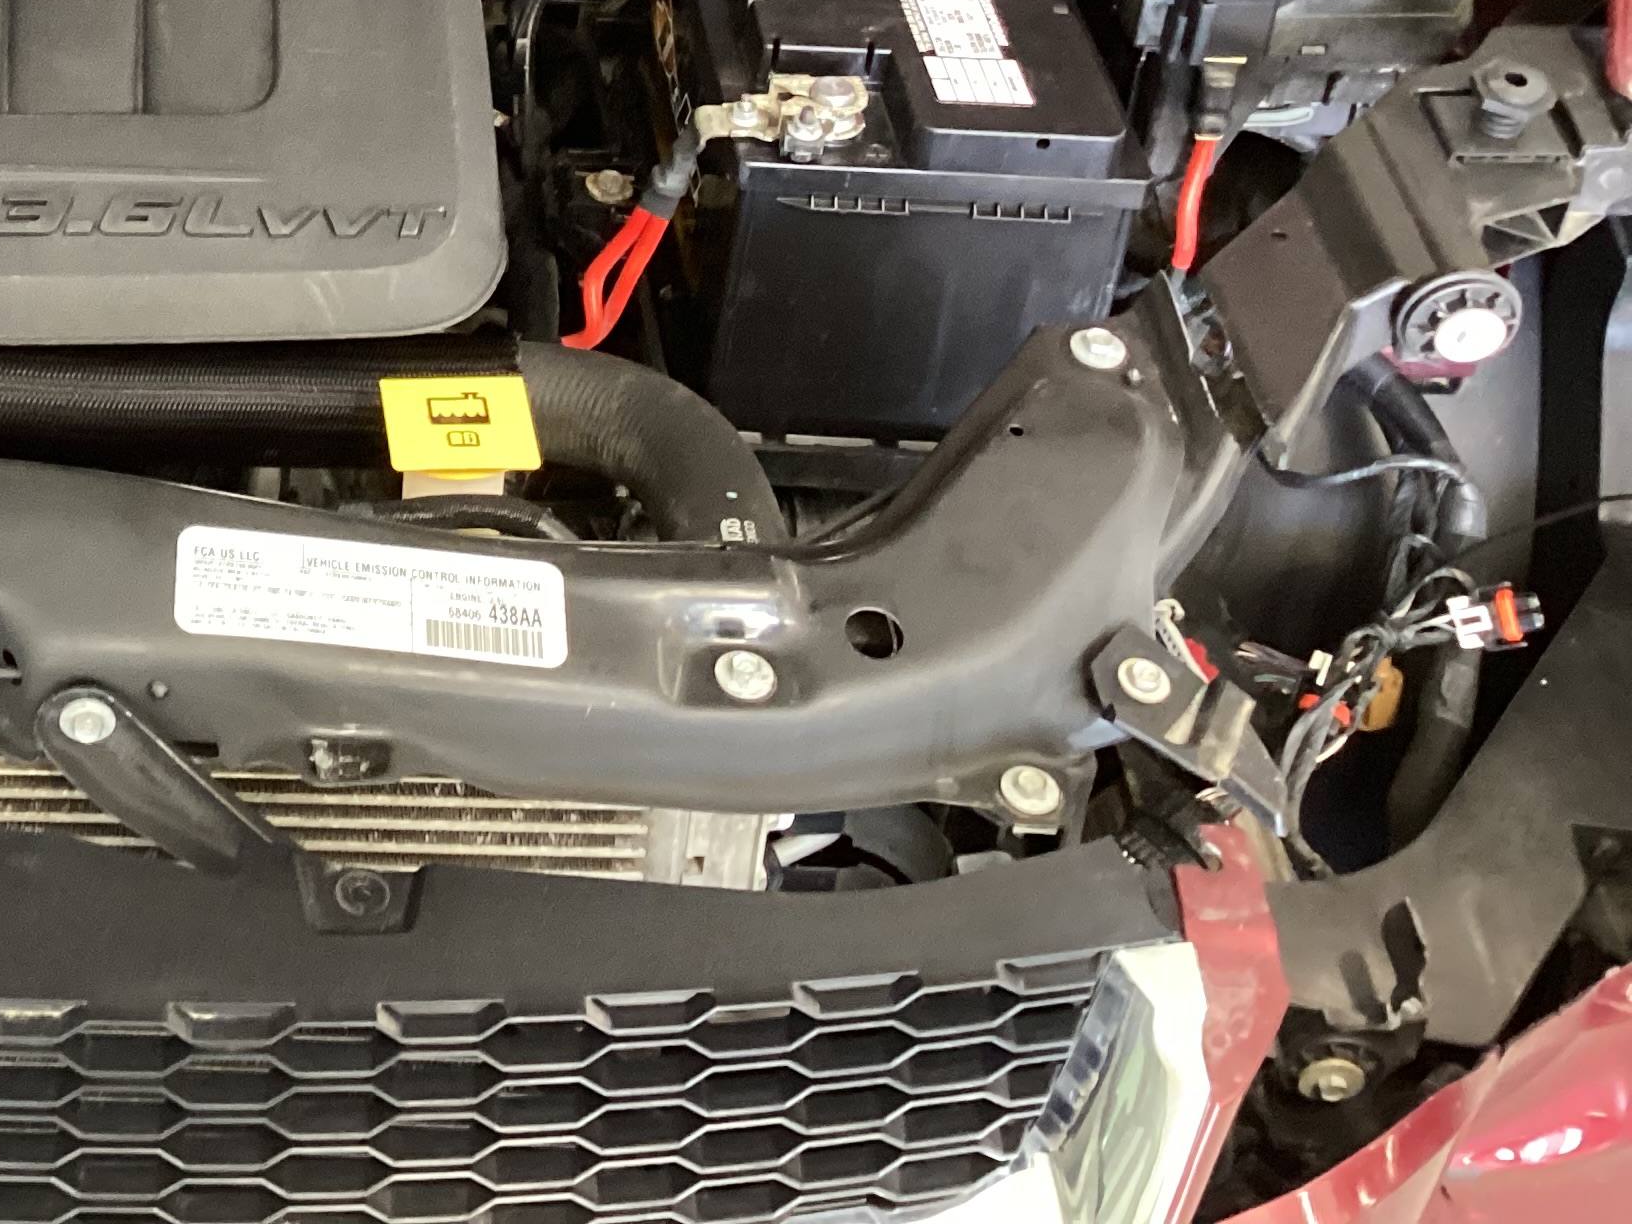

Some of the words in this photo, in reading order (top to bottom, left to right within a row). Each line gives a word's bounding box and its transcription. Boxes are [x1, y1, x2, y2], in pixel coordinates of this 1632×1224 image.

[193, 545, 216, 558] FCA
[220, 547, 236, 561] US
[239, 550, 261, 563] LLC
[306, 556, 350, 573] VEHICLE
[355, 561, 407, 579] EMISSION
[411, 567, 461, 585] CONTROL
[465, 574, 542, 593] INFORMATION
[488, 604, 543, 628] 438AA
